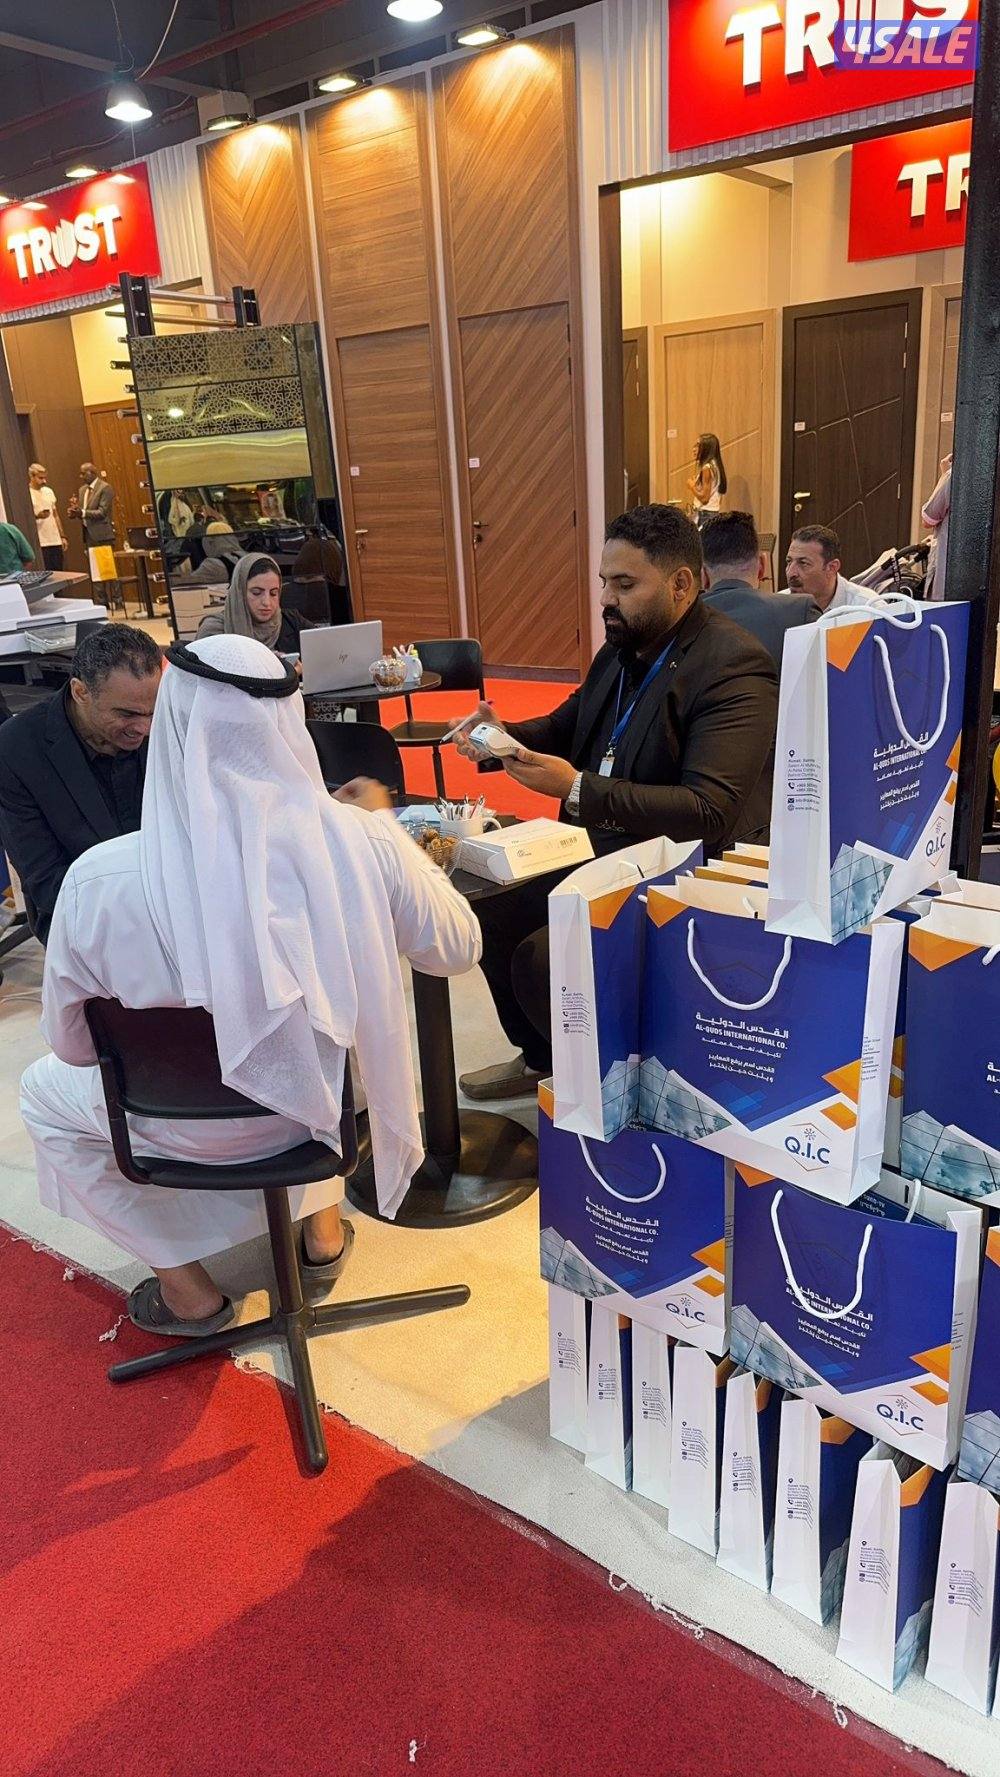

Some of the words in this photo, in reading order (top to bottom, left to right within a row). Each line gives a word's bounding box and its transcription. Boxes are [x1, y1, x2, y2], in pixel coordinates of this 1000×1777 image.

[7, 204, 120, 280] TRUST
[925, 832, 947, 857] Q.I.C
[695, 1011, 745, 1029] الدولية
[746, 1026, 789, 1039] القدس
[695, 1023, 723, 1036] AL-QUDS
[724, 1029, 776, 1047] INTERNATIONAL
[776, 1041, 788, 1050] CO.
[784, 1136, 831, 1165] Q.I.C
[585, 1195, 622, 1219] الدولية
[585, 1205, 605, 1221] AL-QUDS
[604, 1216, 649, 1234] INTERNATIONAL
[648, 1228, 659, 1236] CO.
[621, 1216, 659, 1227] القدس
[665, 1302, 706, 1323] Q.I.C
[810, 1300, 861, 1327] INTERNONAL
[860, 1321, 873, 1331] CO.
[832, 1302, 873, 1321] القس
[876, 1403, 924, 1431] Q.I.C
